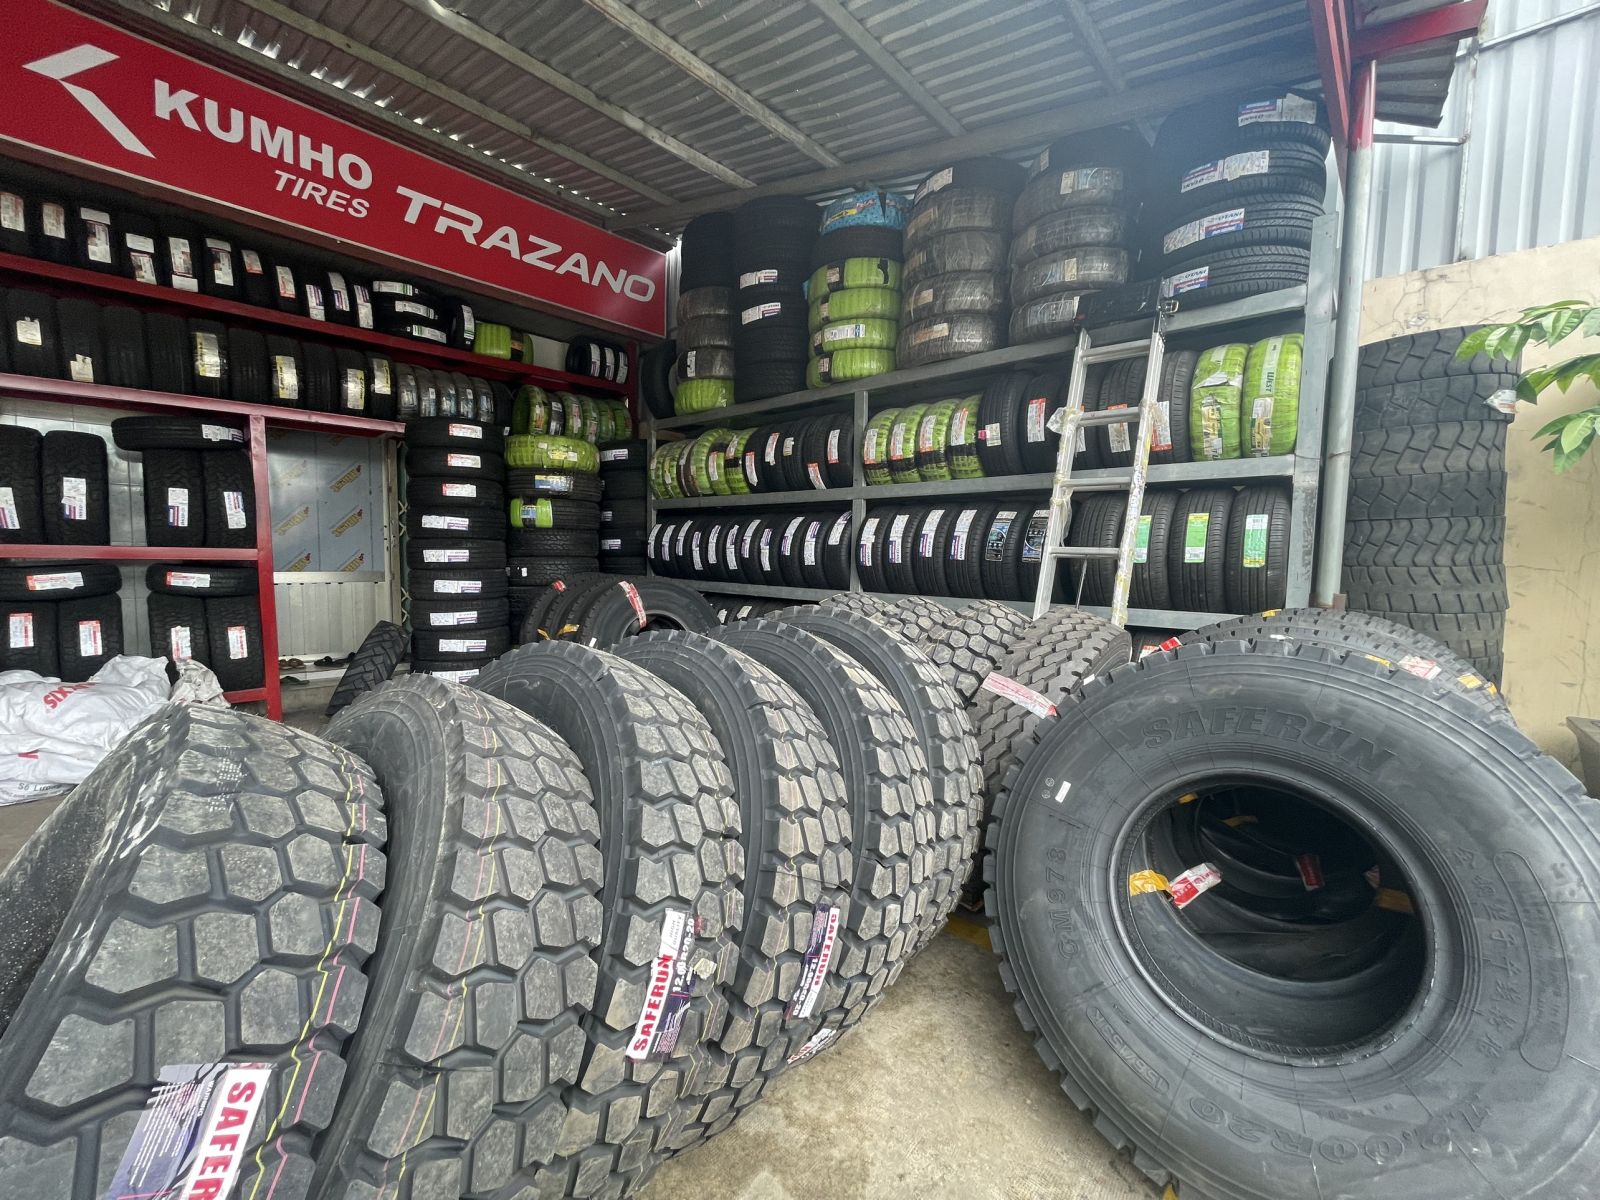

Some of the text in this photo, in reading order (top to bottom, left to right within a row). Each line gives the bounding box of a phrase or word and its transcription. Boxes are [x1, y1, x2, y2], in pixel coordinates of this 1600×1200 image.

[155, 78, 373, 190] KUMHO
[275, 169, 370, 218] TIRES
[396, 185, 656, 302] TRAZANO
[1143, 706, 1399, 773] SAFERUN
[633, 953, 674, 1051] SAFERUN
